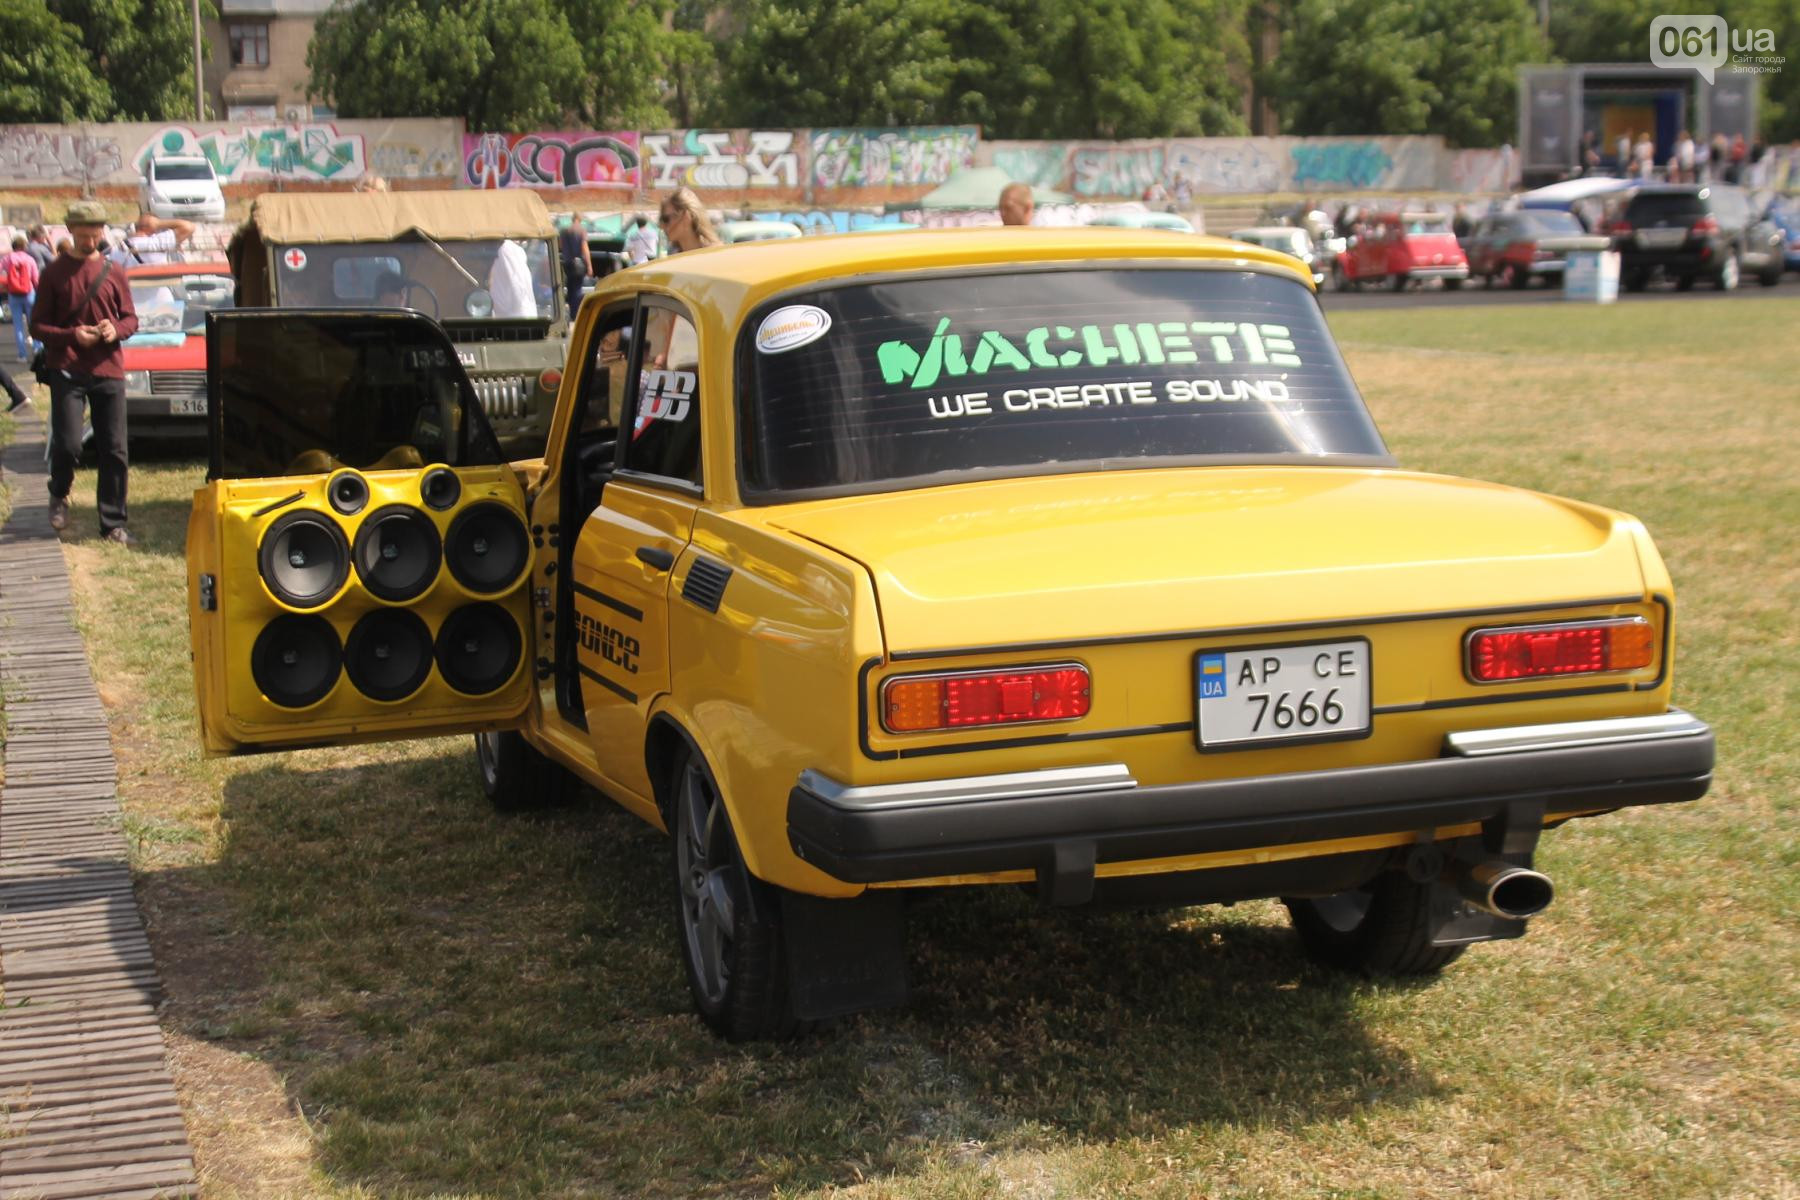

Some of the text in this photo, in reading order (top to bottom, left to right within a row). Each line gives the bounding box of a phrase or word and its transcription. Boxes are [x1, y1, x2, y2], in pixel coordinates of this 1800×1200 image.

[877, 316, 1302, 388] MACHETE
[928, 379, 1290, 419] WE CREATE SOUND
[1203, 681, 1223, 696] UA
[1238, 650, 1358, 687] AP CE
[1247, 688, 1344, 733] 7666
